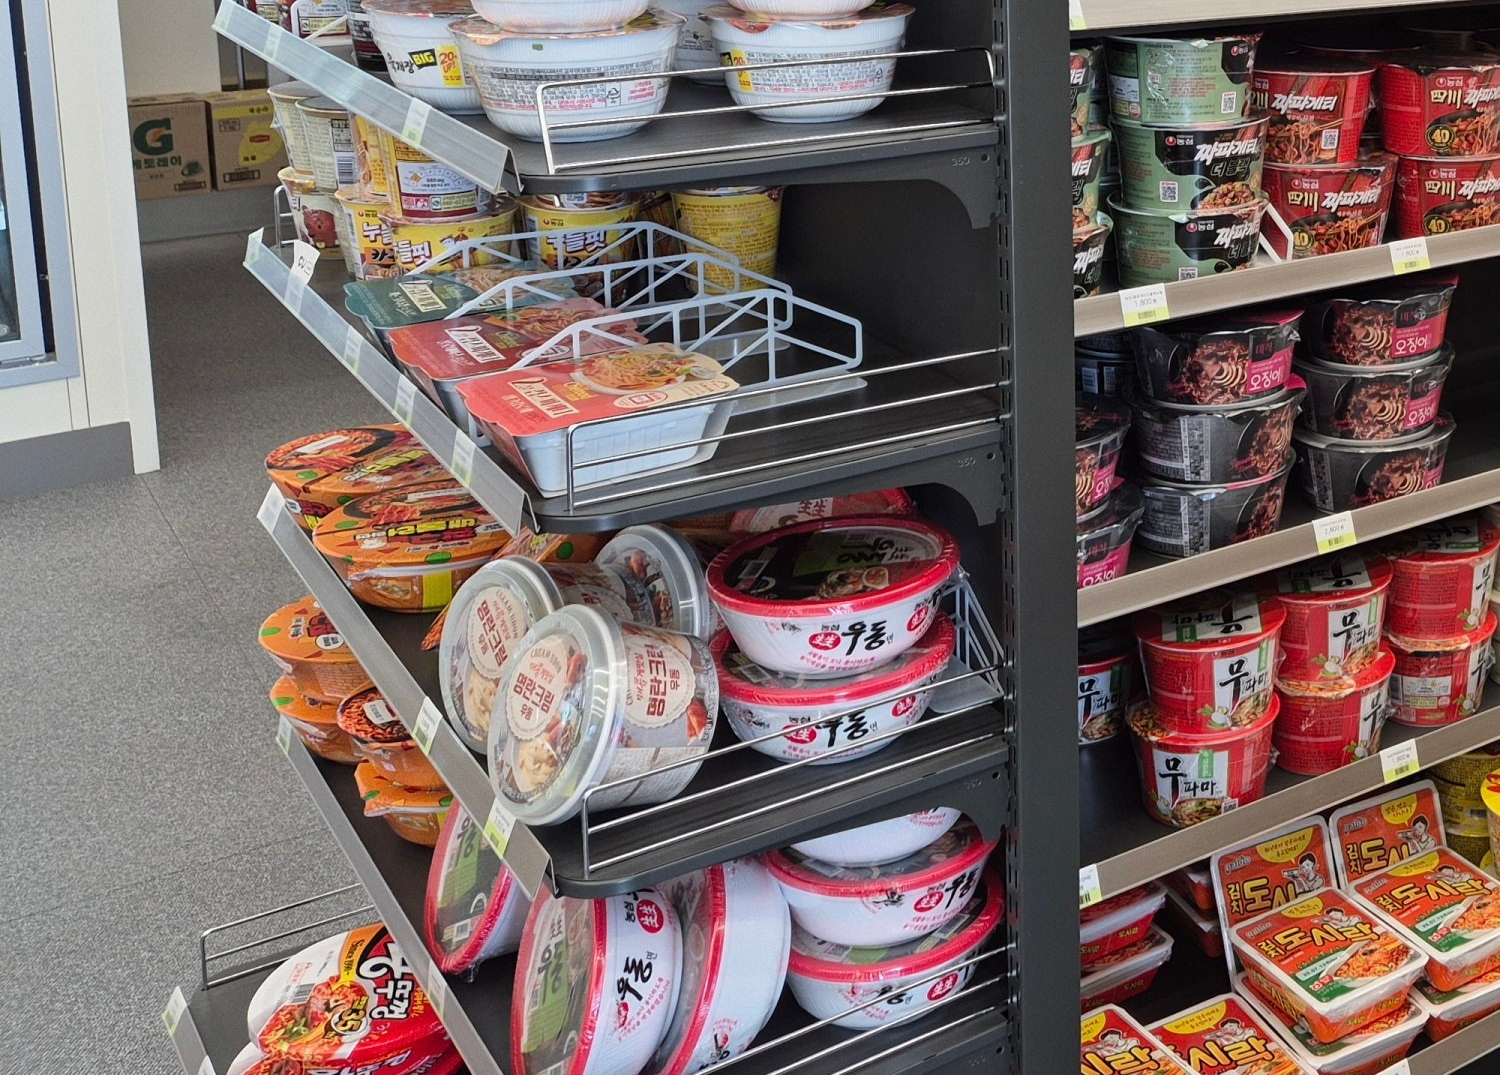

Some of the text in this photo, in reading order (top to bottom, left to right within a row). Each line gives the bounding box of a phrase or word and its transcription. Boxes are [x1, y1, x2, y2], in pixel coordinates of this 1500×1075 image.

[414, 50, 435, 67] BIG
[1271, 93, 1337, 114] 짜파게티
[133, 118, 173, 156] G
[1196, 138, 1259, 164] 짜파게티
[1288, 184, 1380, 213] 四川 짜파게티
[1396, 334, 1428, 353] 오징어
[1250, 371, 1283, 390] 오징어
[841, 620, 887, 656] 우동
[513, 673, 555, 714] 명란크림
[645, 644, 667, 716] 명란크림
[1218, 657, 1268, 717] 무파마
[521, 703, 534, 721] 우동
[1159, 757, 1217, 808] 무파마
[1346, 844, 1362, 874] 김치
[1228, 882, 1244, 915] 김치
[1376, 893, 1402, 914] 김치
[1392, 878, 1493, 906] 도시락
[1257, 938, 1283, 958] 김치
[1279, 920, 1376, 953] 도시락
